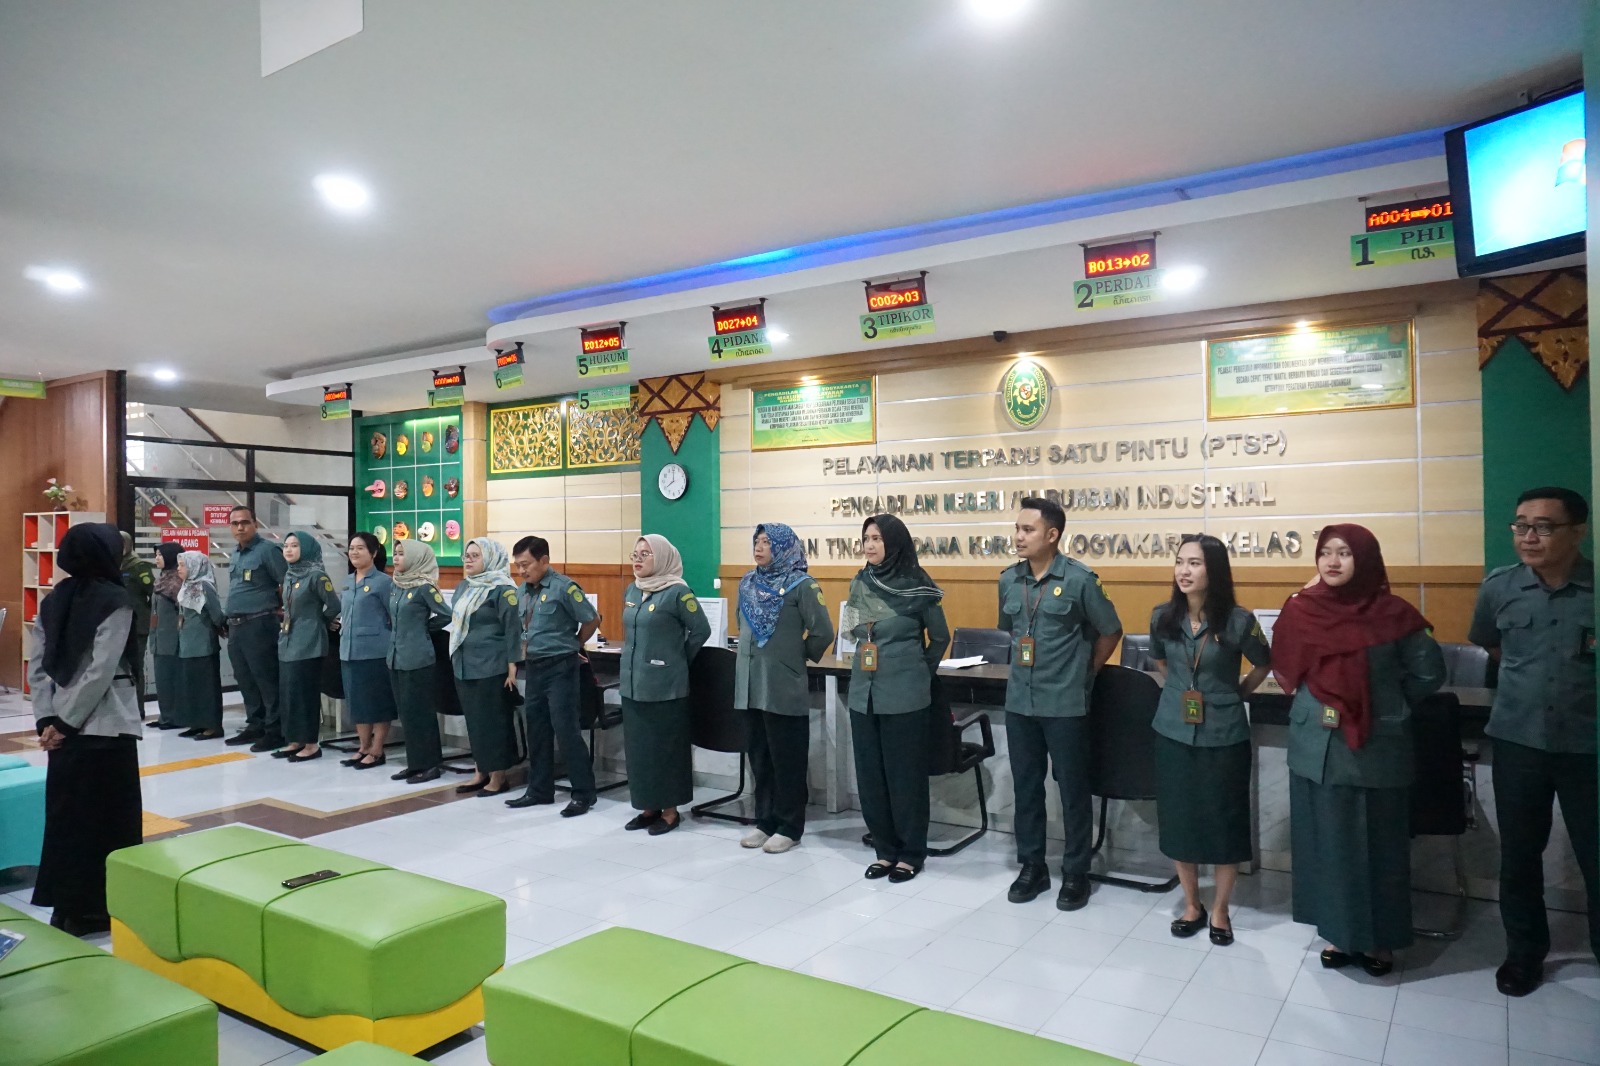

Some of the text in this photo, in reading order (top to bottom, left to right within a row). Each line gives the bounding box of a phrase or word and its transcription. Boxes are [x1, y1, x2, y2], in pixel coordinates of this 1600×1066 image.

[1367, 207, 1411, 228] A004
[1400, 226, 1446, 245] PHI
[1355, 237, 1375, 267] 1
[1087, 253, 1150, 274] B013 02
[1095, 274, 1161, 295] PERDAT
[869, 290, 920, 308] C002 03
[1076, 283, 1094, 308] 2
[716, 315, 759, 331] D027 04
[878, 308, 932, 326] TIPIKOR
[863, 317, 878, 339] 3
[608, 336, 620, 347] 05
[711, 338, 723, 359] 4
[578, 358, 589, 375] 5
[589, 351, 626, 365] HUKUM
[495, 372, 503, 389] 6
[428, 391, 435, 407] 7
[579, 392, 590, 410] 5
[321, 405, 328, 419] 8
[823, 430, 1288, 476] PELAYANAN TERPADU SATU PINTU (PTSP)
[830, 493, 940, 517] PENGADILAN
[943, 489, 1005, 514] NEGERI
[1137, 481, 1277, 509] INDUSTRIAL
[1220, 530, 1303, 558] KELAS
